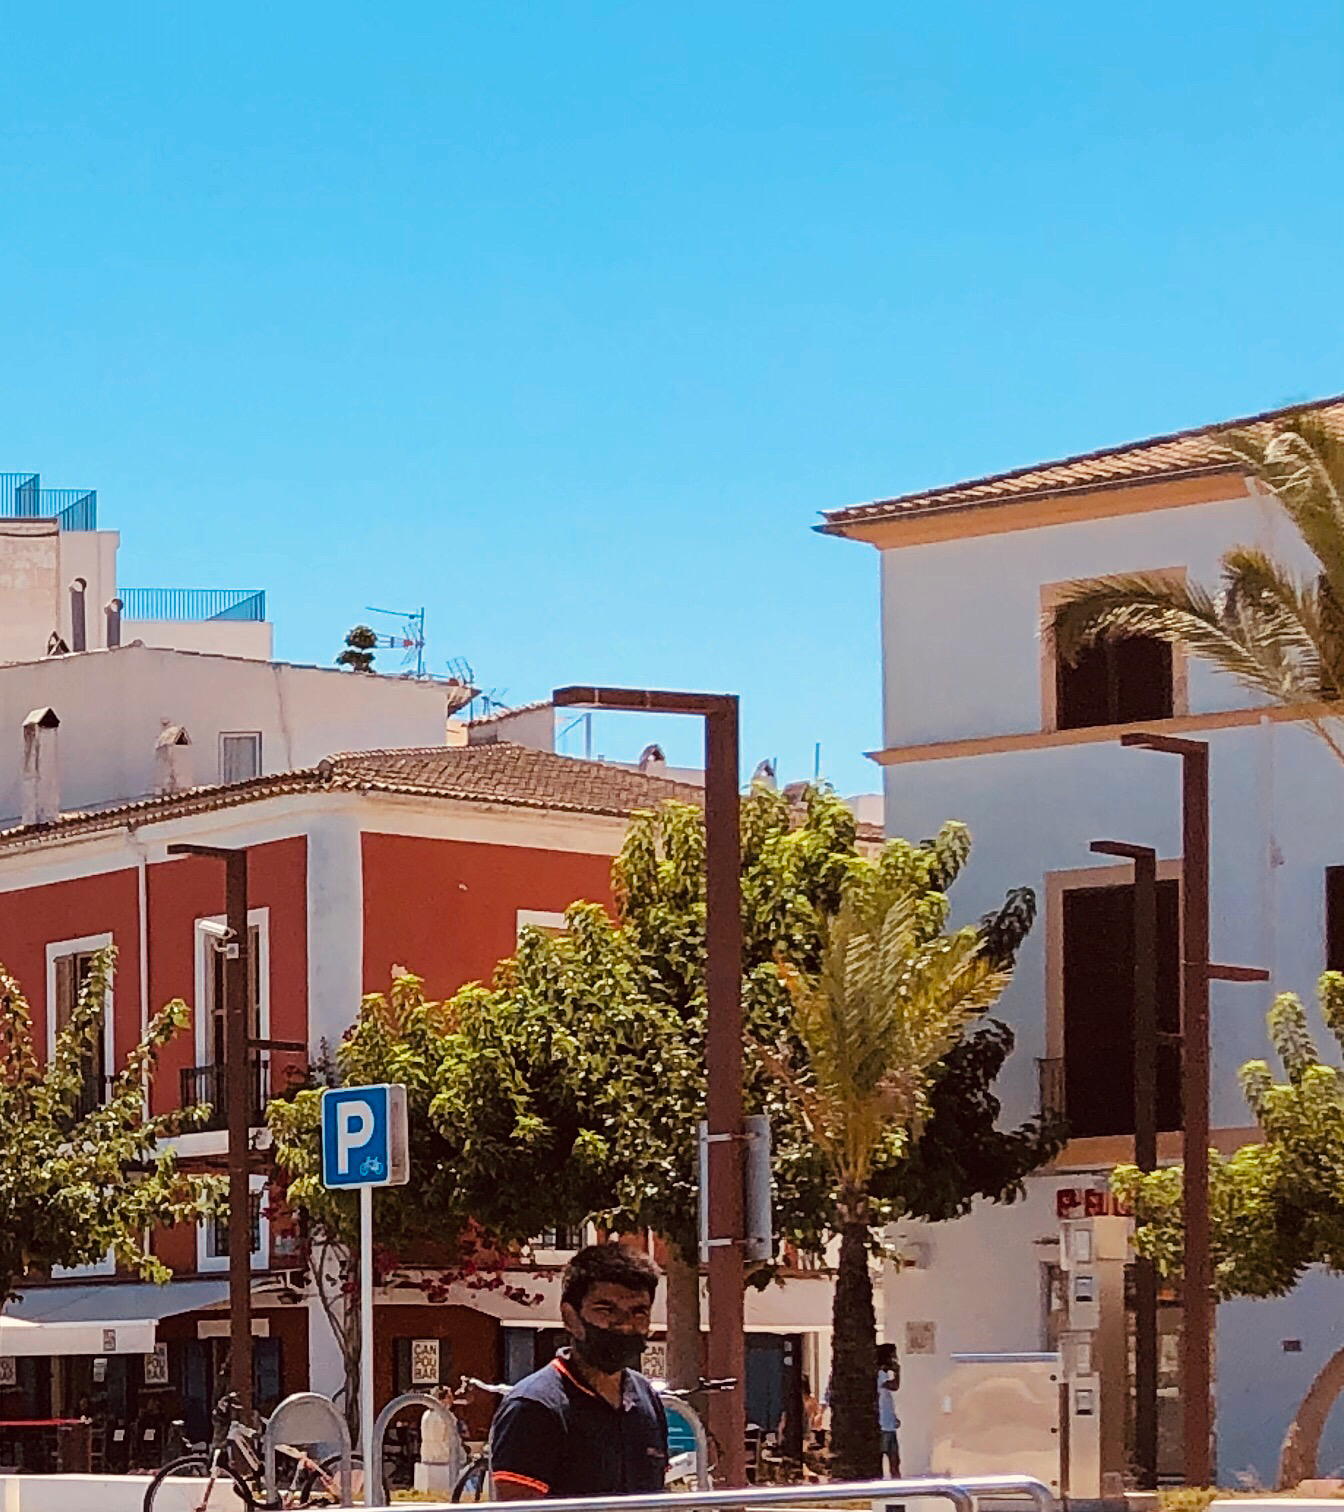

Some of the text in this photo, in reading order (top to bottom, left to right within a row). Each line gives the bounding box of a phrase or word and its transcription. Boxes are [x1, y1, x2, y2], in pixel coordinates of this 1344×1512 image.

[336, 1100, 375, 1175] P
[414, 1343, 437, 1355] CAN
[414, 1356, 437, 1367] POU
[414, 1368, 437, 1380] BAR
